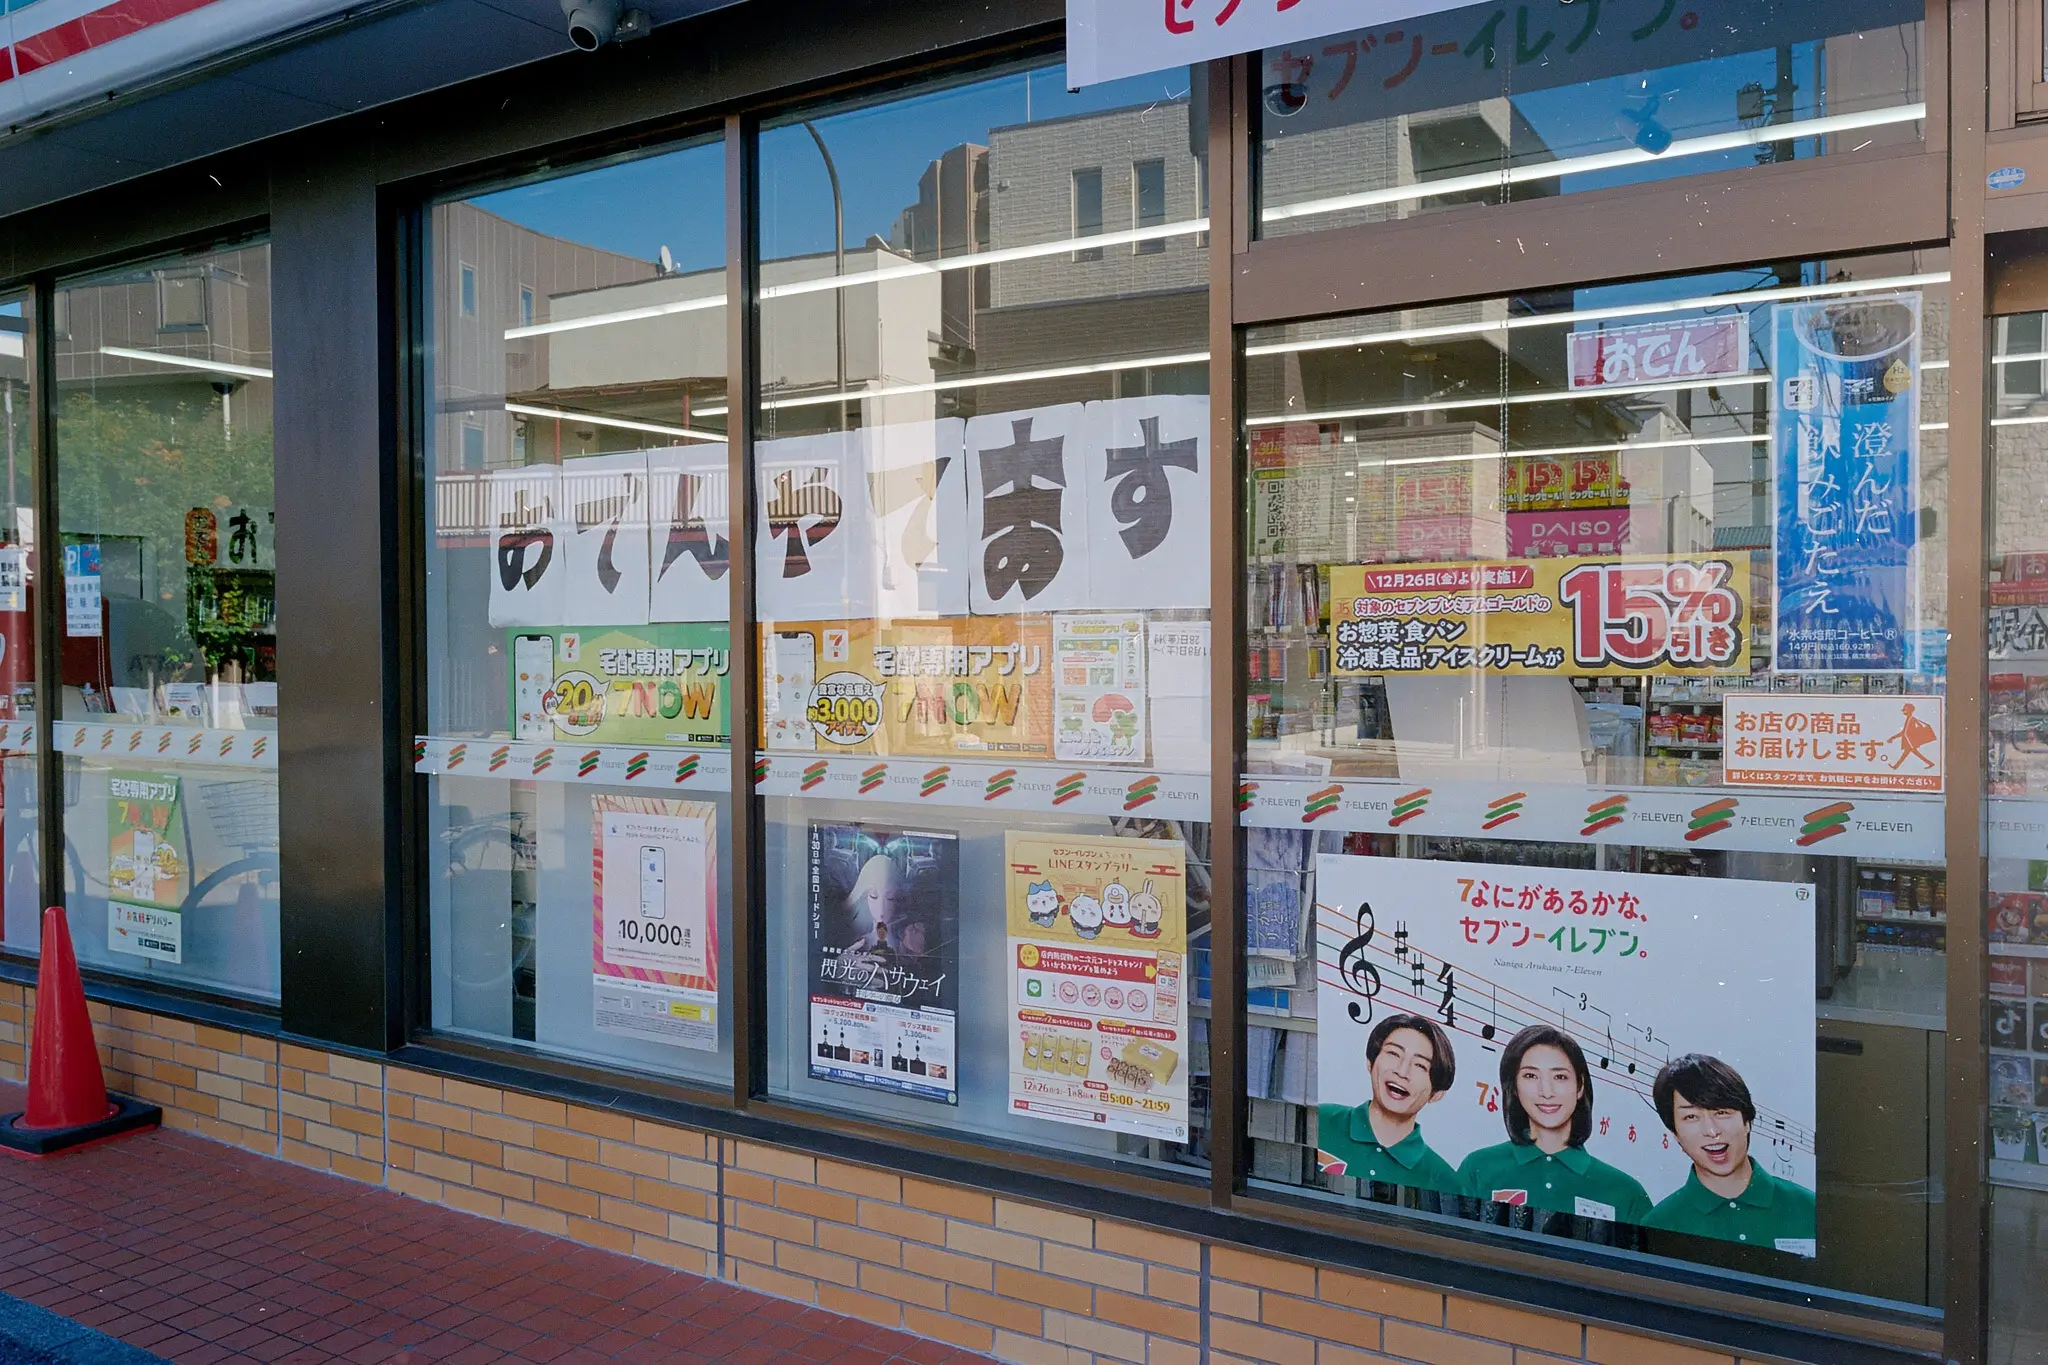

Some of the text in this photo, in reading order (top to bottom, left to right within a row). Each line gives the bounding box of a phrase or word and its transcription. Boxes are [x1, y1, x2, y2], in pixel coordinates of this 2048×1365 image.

[1602, 332, 1706, 384] おでん
[1852, 422, 1893, 535] 澄んだ
[1531, 520, 1612, 537] DAISO
[1376, 569, 1518, 588] 12月26日(金)より実施!
[1355, 593, 1551, 617] 対象のセブンプレミアムゴールドの
[1560, 564, 1737, 664] 15%
[1670, 625, 1735, 661] 引き
[600, 647, 730, 676] 宅配専用アプリ
[873, 643, 1041, 676] 宅配専用アプリ
[613, 680, 716, 719] 7NOW
[817, 683, 873, 697] 豊富な品揃え
[893, 678, 1023, 725] 7NOW
[1735, 711, 1861, 735] お店の商品
[1734, 737, 1889, 762] お届けします。
[111, 778, 176, 802] 宅配専用アプリ
[1048, 859, 1139, 873] LINEスタンプラリー
[1457, 878, 1648, 922] 7なにがあるかな、
[1459, 916, 1648, 959] セブン-イレブン。
[820, 958, 947, 998] 閃光のハサウェイ
[1493, 956, 1603, 978] Naniga Arukana 7-Eleven
